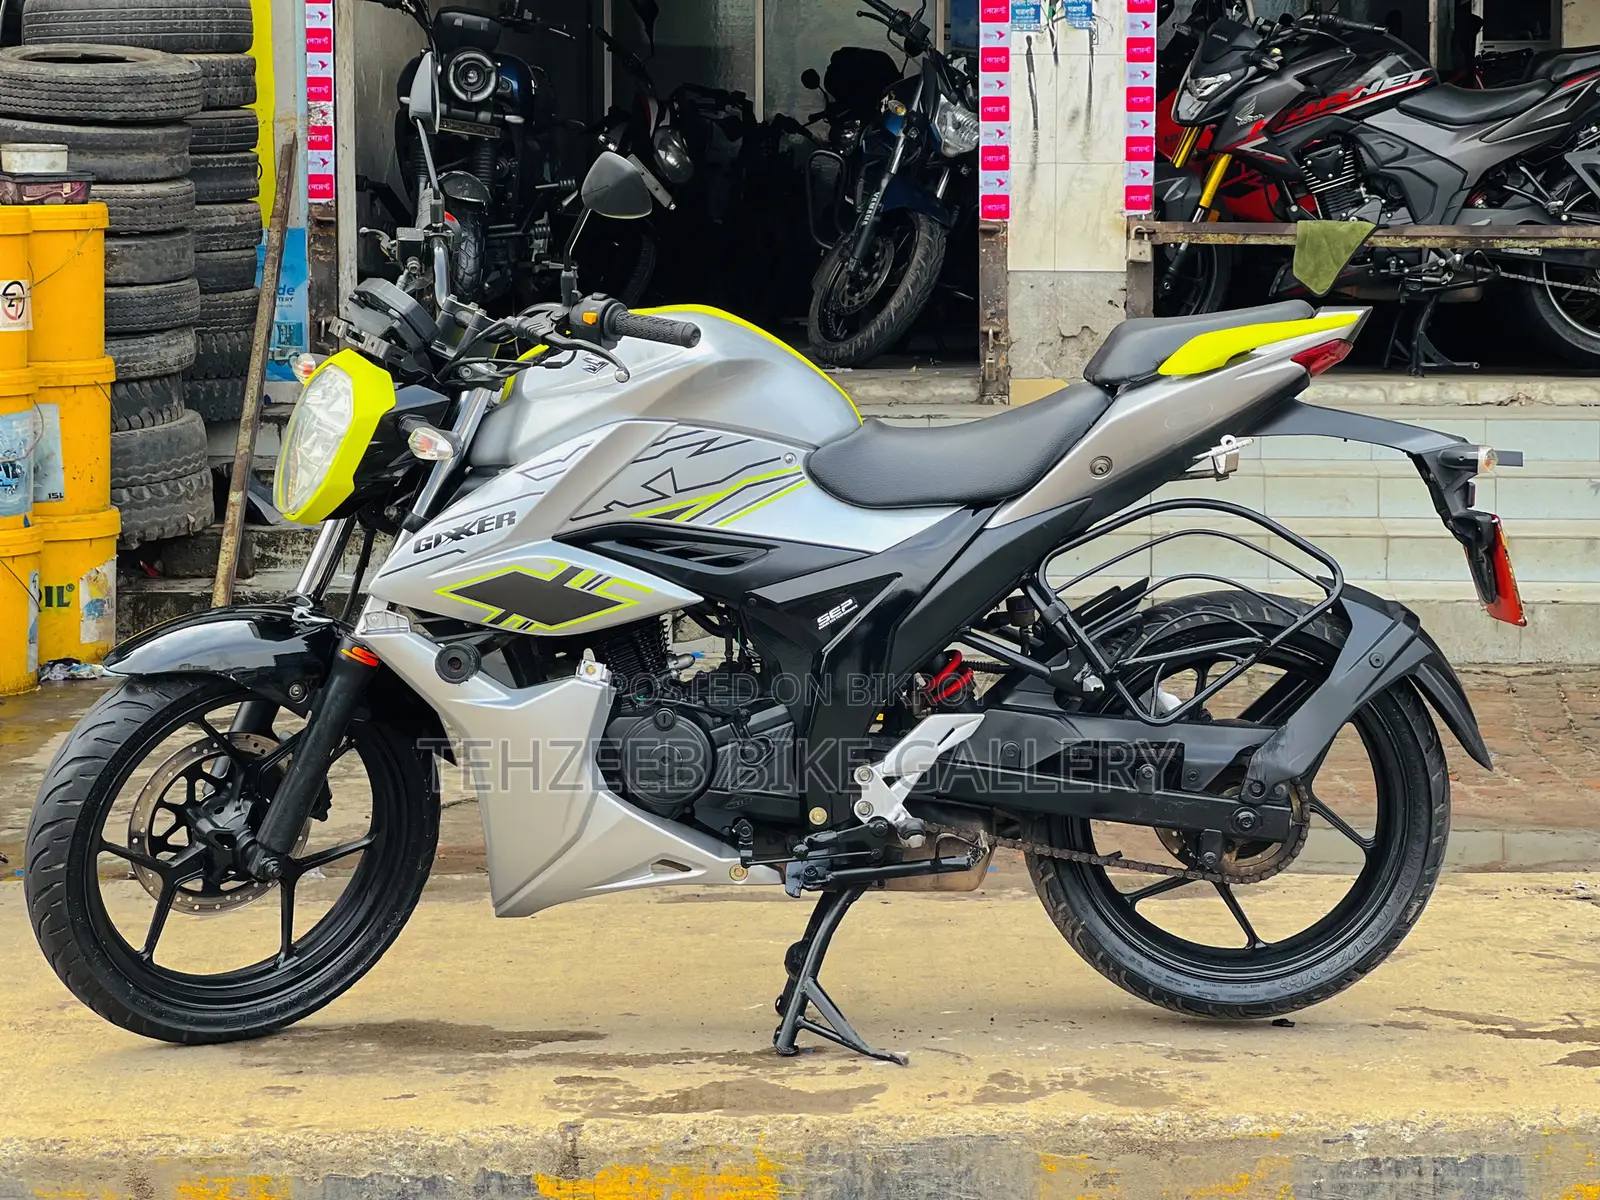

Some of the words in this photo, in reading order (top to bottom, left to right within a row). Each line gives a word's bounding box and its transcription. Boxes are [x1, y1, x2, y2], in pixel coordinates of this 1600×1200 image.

[1236, 113, 1265, 127] HONDA
[48, 492, 64, 500] 15L
[817, 598, 854, 624] SEP
